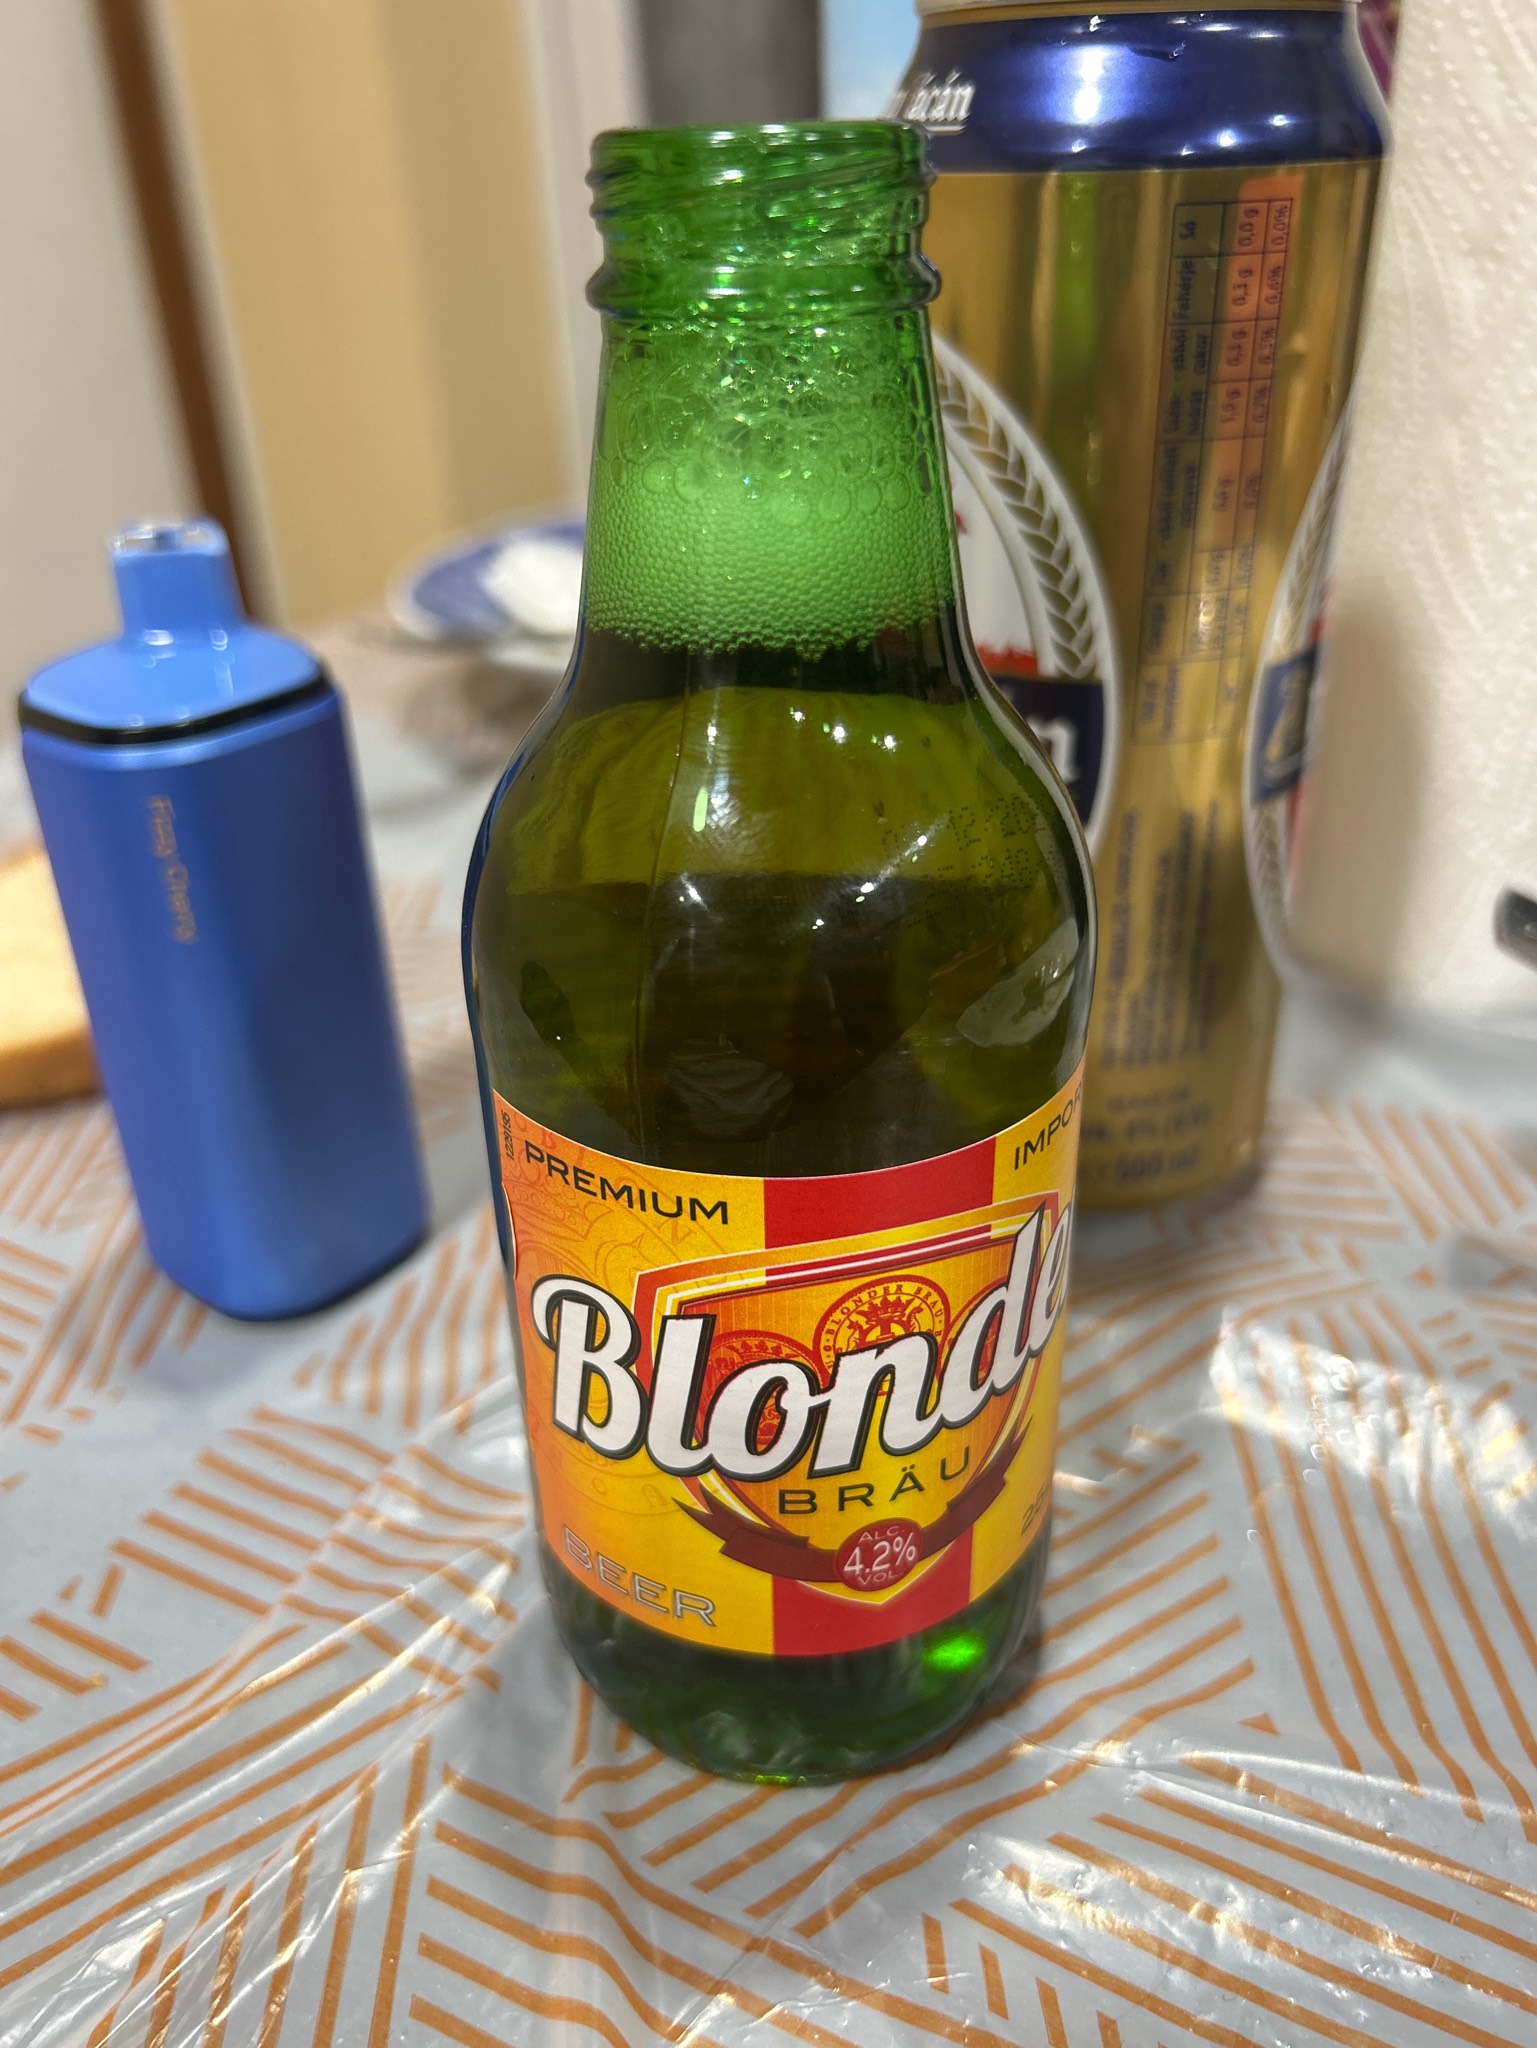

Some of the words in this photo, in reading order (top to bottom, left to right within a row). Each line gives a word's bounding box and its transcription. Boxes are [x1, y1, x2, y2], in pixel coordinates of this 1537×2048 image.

[524, 1139, 729, 1225] PREMIUM
[529, 1195, 1075, 1481] Blonde
[825, 1284, 903, 1336] BLONDER
[778, 1446, 970, 1515] BRÄU
[562, 1523, 717, 1627] BEER
[843, 1531, 916, 1575] 4.2%
